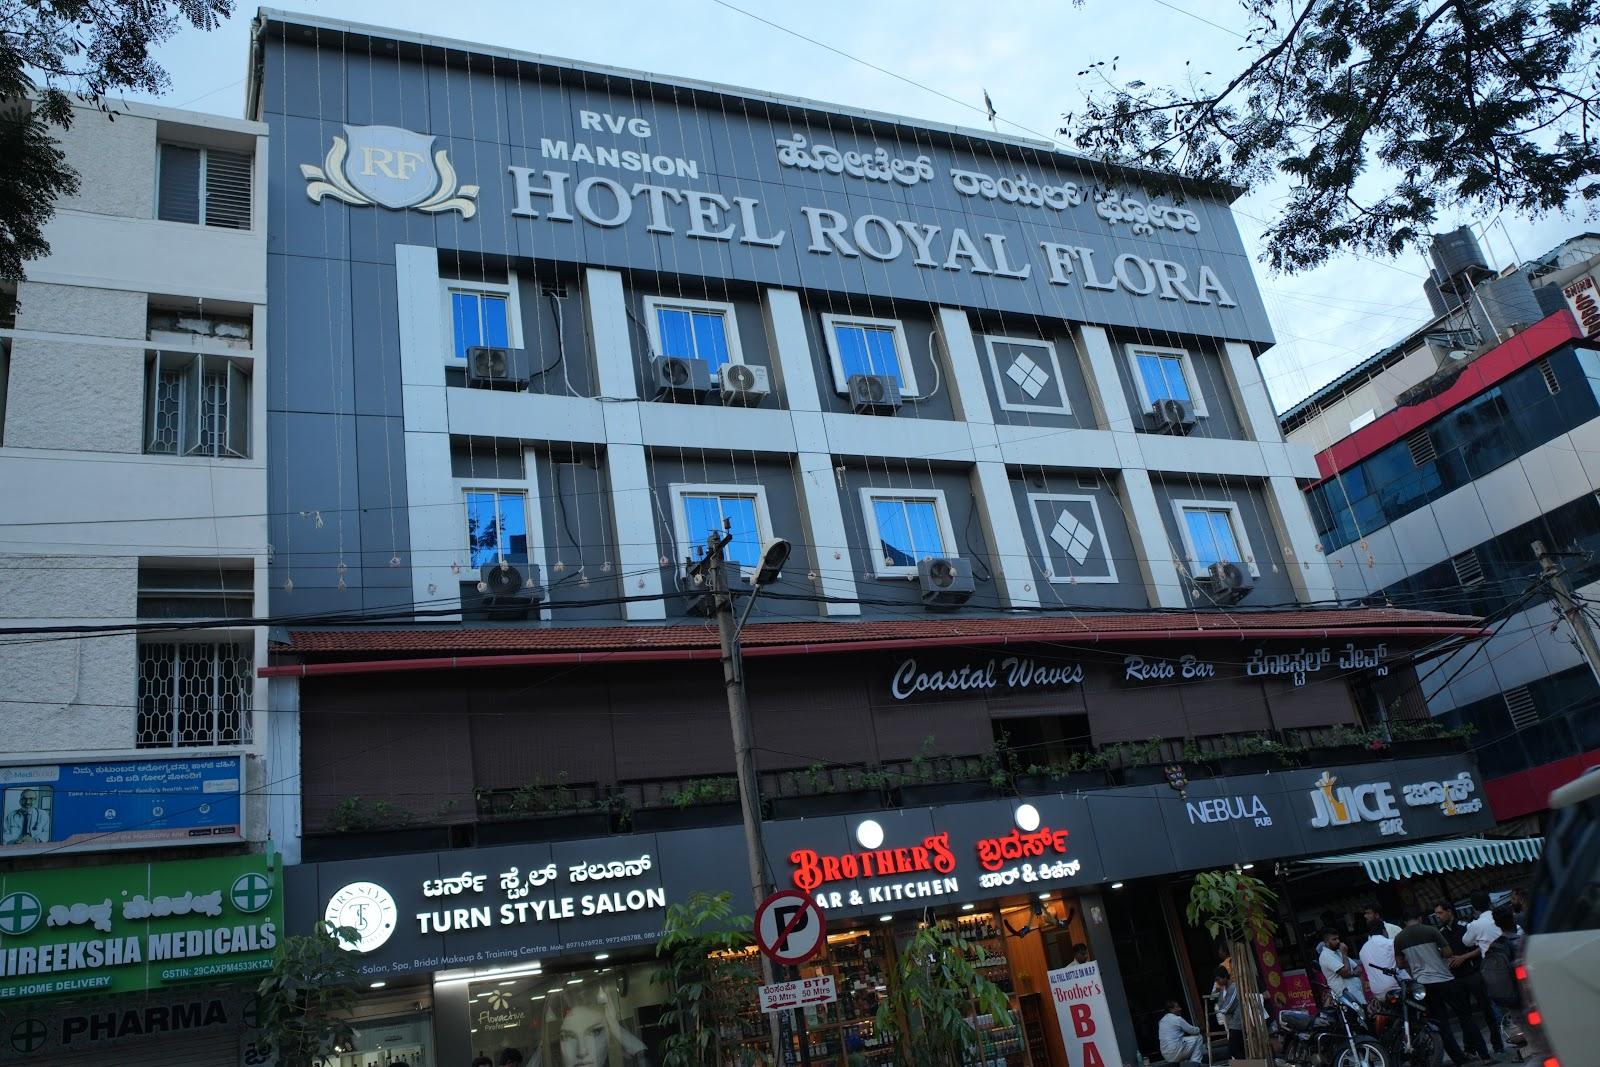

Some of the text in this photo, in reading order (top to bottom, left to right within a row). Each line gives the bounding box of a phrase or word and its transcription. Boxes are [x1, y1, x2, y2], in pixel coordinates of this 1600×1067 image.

[580, 110, 652, 138] RVG
[360, 146, 425, 181] RF
[540, 137, 699, 180] MANSION
[776, 133, 935, 187] ಹೋಟೆಲ್
[950, 168, 1082, 212] ರಾಯಲ್
[508, 165, 1238, 309] HOTEL ROYAL FLORA
[891, 657, 1085, 700] Coastal Waves
[1124, 655, 1216, 681] Resto Bar
[1186, 795, 1268, 825] NEBULA
[1310, 780, 1400, 828] JUICE
[1254, 817, 1272, 828] PUB
[814, 877, 959, 910] AR & KITCHEN
[416, 887, 666, 934] TURN STYLE SALON
[149, 922, 277, 961] MEDICALS
[161, 968, 192, 981] GSTIN:
[392, 960, 411, 973] Spa,
[414, 957, 437, 968] Bridal
[439, 954, 474, 967] Makeup
[476, 951, 483, 960] &
[485, 947, 518, 960] Training
[0, 975, 111, 998] EE HOME DELIVERY
[767, 991, 797, 1003] 50 Mtrs
[801, 985, 831, 998] 50 Mtrs
[803, 976, 830, 989] BTP
[1055, 981, 1101, 1002] Brother's
[62, 1000, 228, 1044] PHARMA
